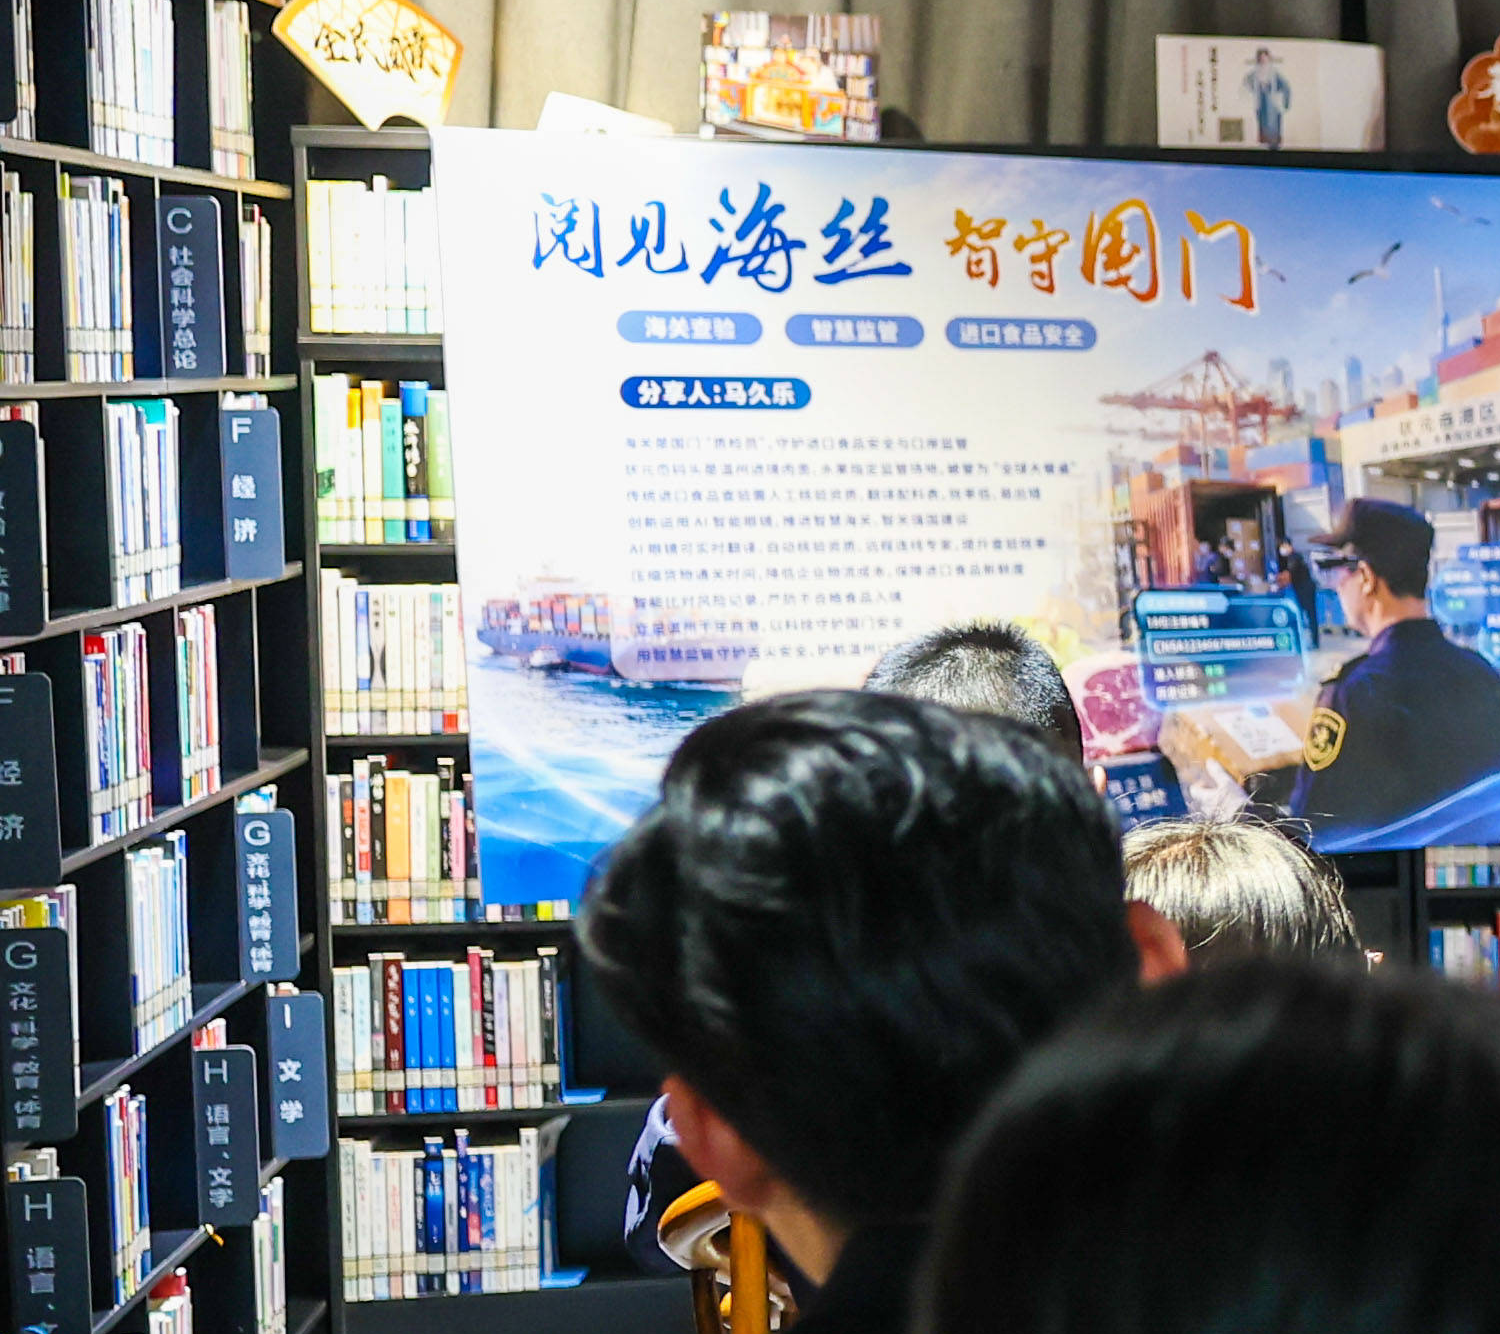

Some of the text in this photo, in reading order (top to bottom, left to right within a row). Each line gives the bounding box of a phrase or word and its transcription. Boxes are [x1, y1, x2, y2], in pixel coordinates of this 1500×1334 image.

[167, 207, 193, 234] C
[531, 181, 1260, 312] 阅见海丝 智守国门
[169, 244, 198, 370] 社会科学总论
[644, 315, 737, 341] 海关查验
[810, 317, 900, 344] 智慧监管
[958, 322, 1085, 347] 进口食品安全
[232, 418, 252, 444] F
[232, 474, 258, 543] 经济
[243, 820, 272, 846] G
[5, 941, 38, 969] G
[203, 1058, 228, 1085] H
[278, 1057, 305, 1124] 文学
[25, 1192, 52, 1222] H
